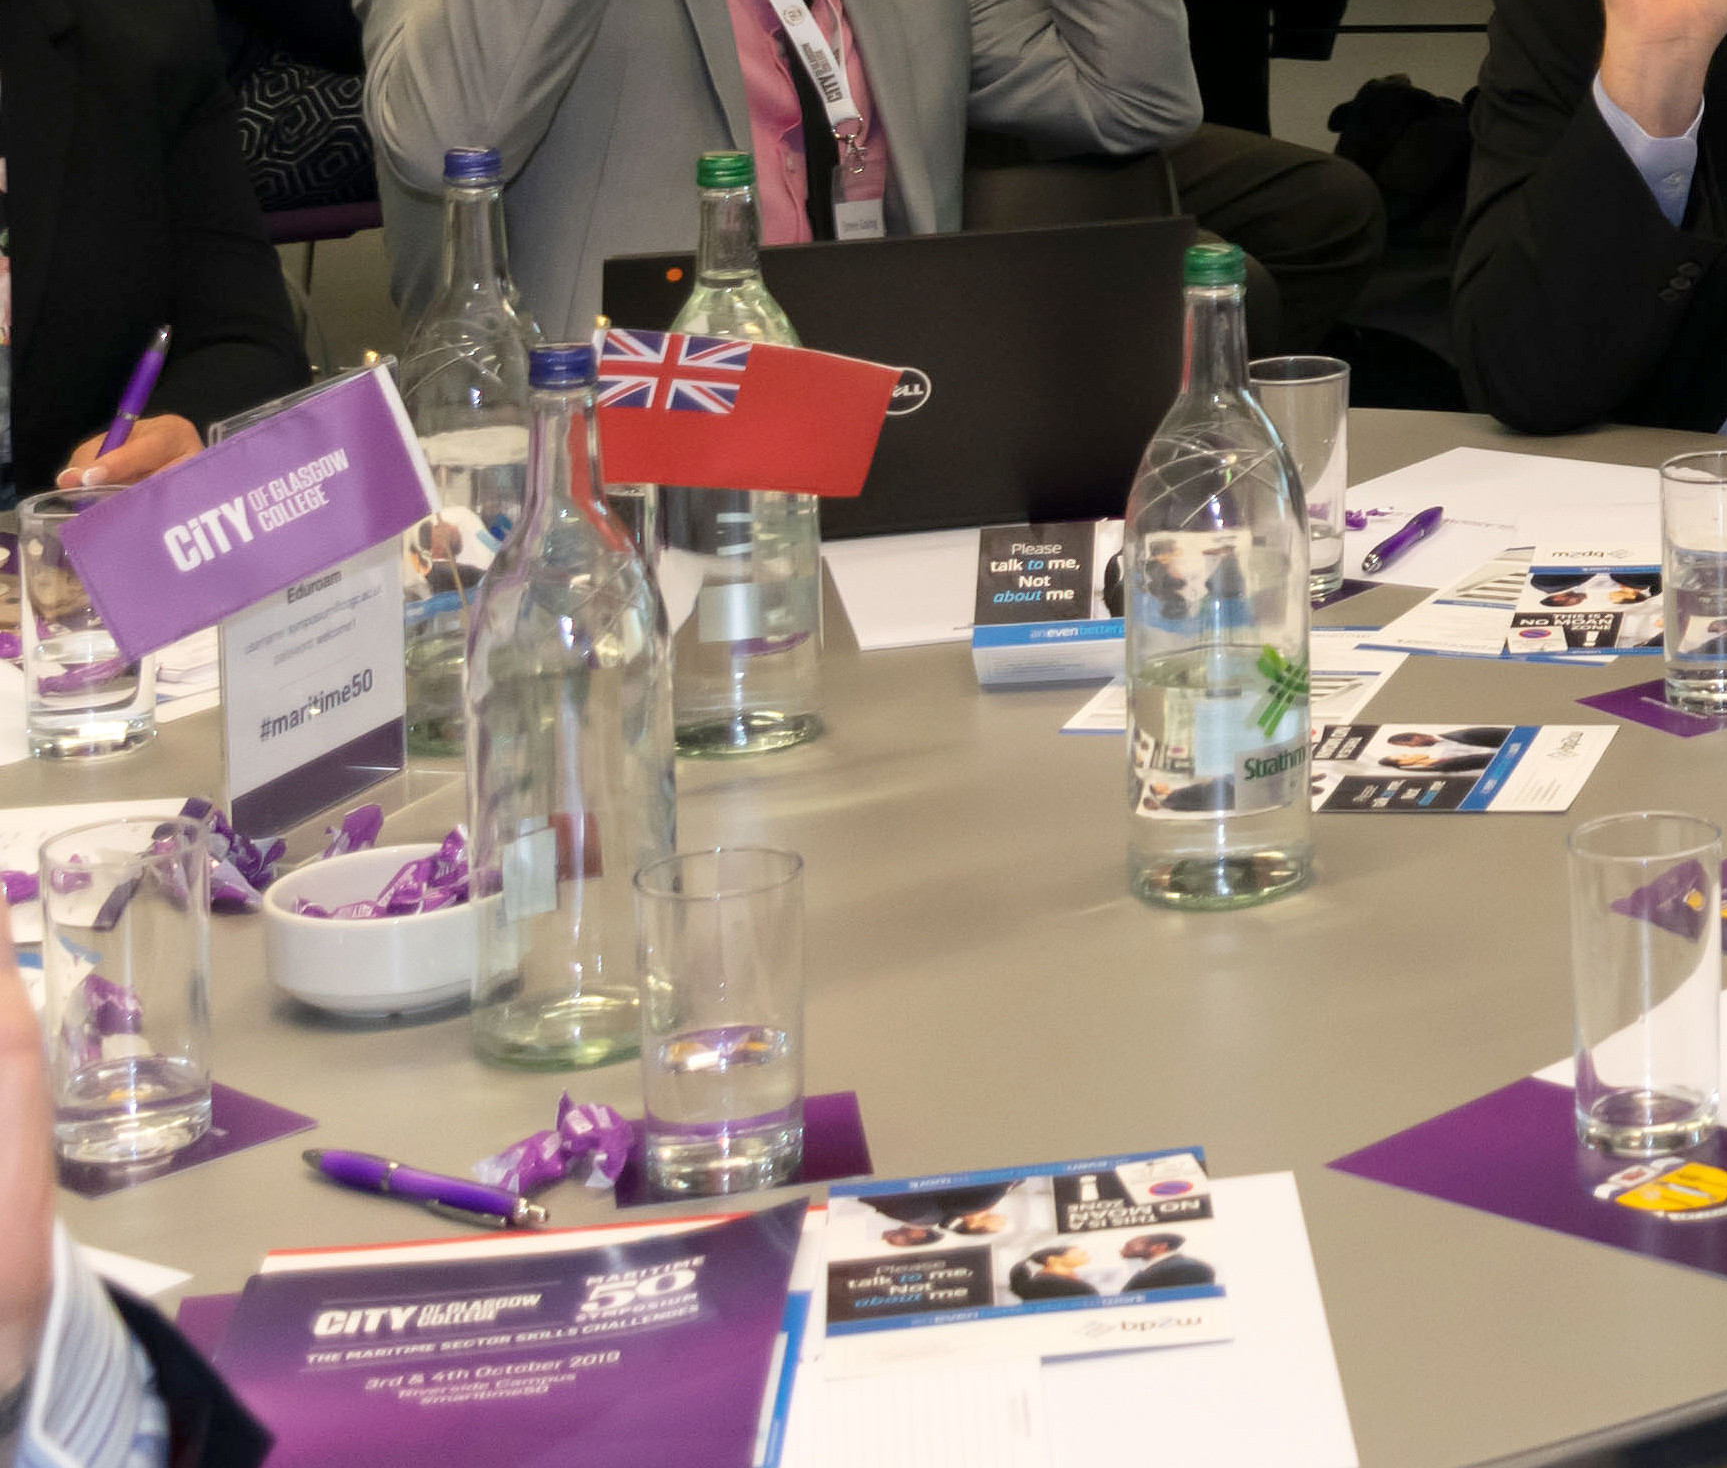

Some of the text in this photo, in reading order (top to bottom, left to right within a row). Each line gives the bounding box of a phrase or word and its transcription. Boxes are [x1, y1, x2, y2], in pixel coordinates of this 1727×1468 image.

[818, 74, 843, 103] CITY
[890, 383, 924, 397] ELL
[248, 485, 270, 512] OF
[268, 448, 350, 502] GLASGOW
[258, 484, 330, 533] COLLEGE
[1011, 542, 1062, 556] Please
[990, 557, 1081, 573] talk to me,
[287, 571, 342, 605] Eduroam
[993, 588, 1075, 604] about me
[1018, 574, 1053, 589] Not
[260, 668, 373, 742] #maritime50
[580, 1270, 697, 1313] 50
[314, 1305, 419, 1337] CITY
[306, 1352, 342, 1365] THE
[345, 1343, 437, 1361] MARITIME
[440, 1334, 512, 1351] SECTOR
[431, 1368, 471, 1383] 4th
[475, 1360, 563, 1379] October
